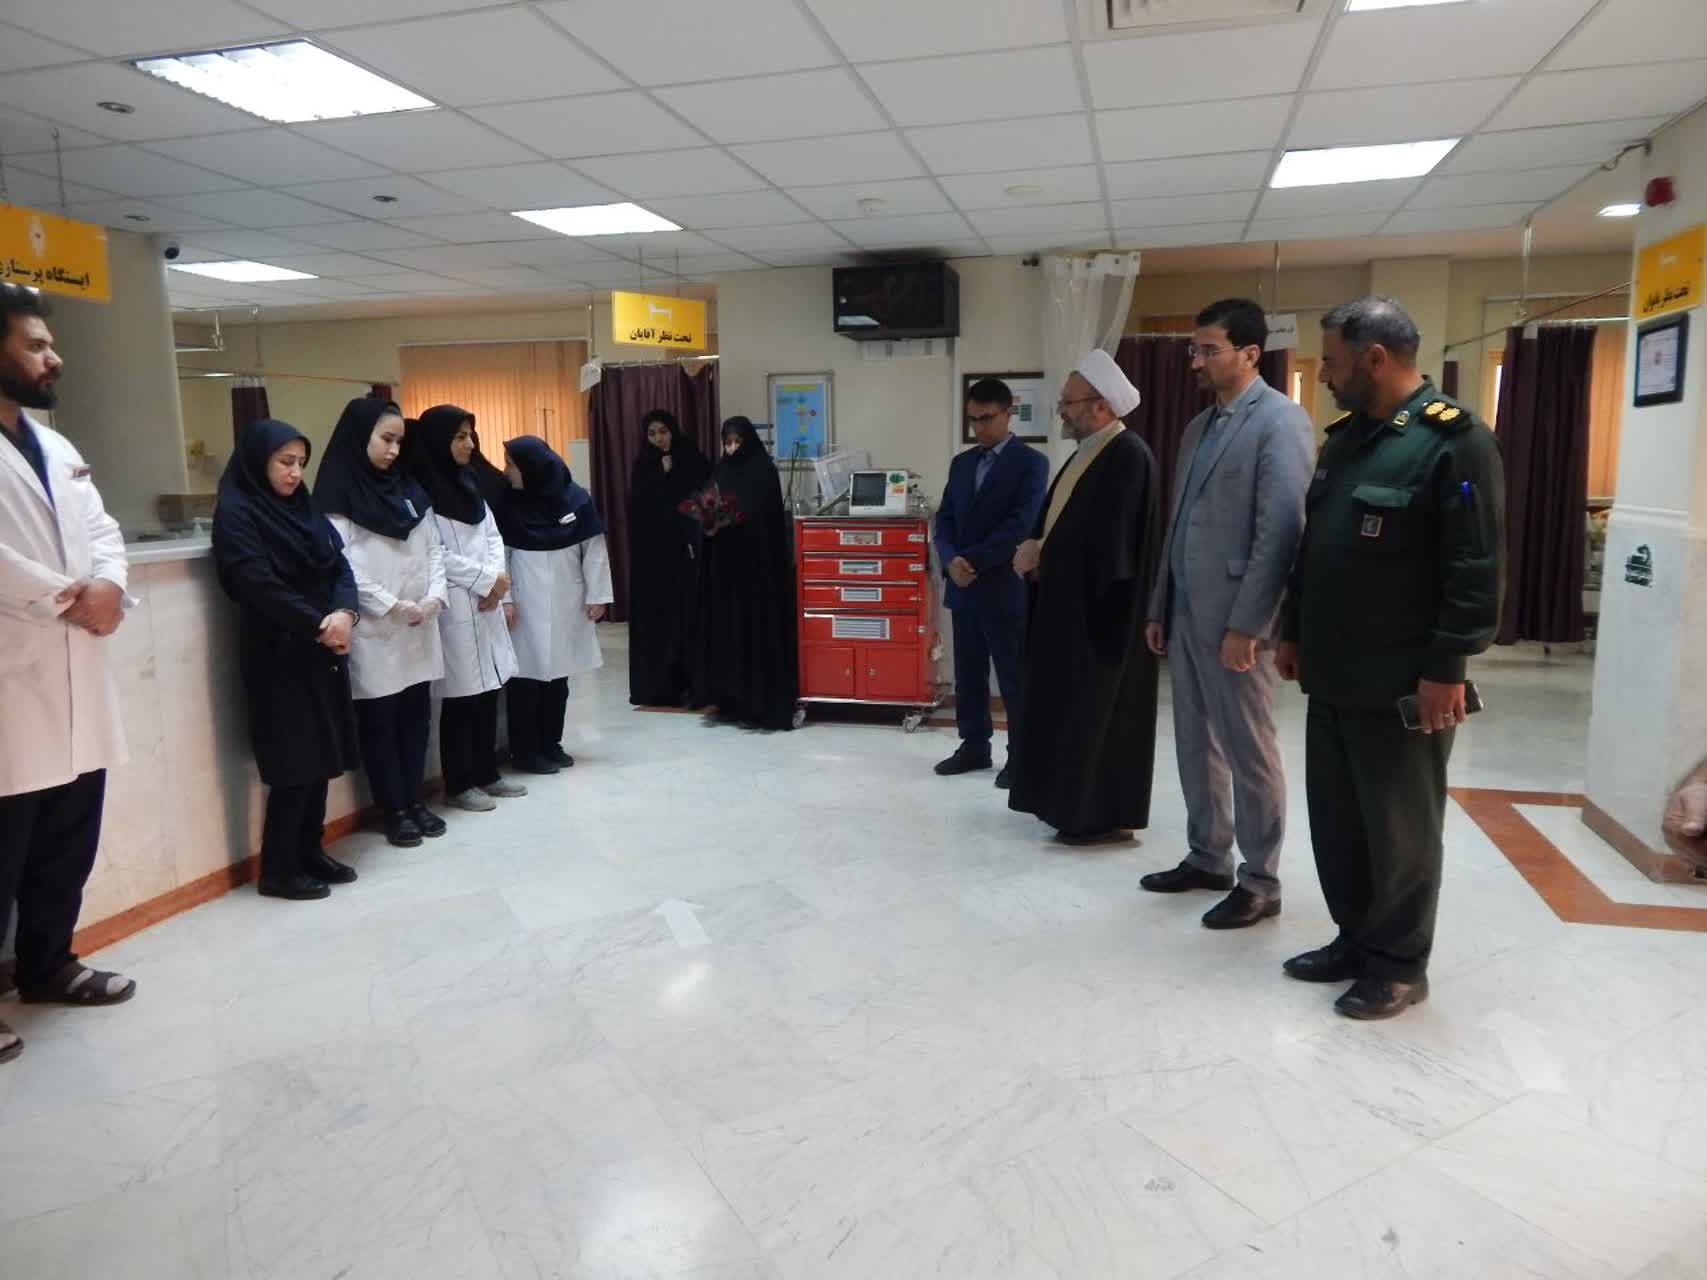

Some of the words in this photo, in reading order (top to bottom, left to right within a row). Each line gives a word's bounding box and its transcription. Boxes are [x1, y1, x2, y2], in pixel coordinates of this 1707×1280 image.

[46, 266, 90, 290] ایستگاه
[629, 326, 656, 341] آقایان
[656, 328, 673, 344] نظر
